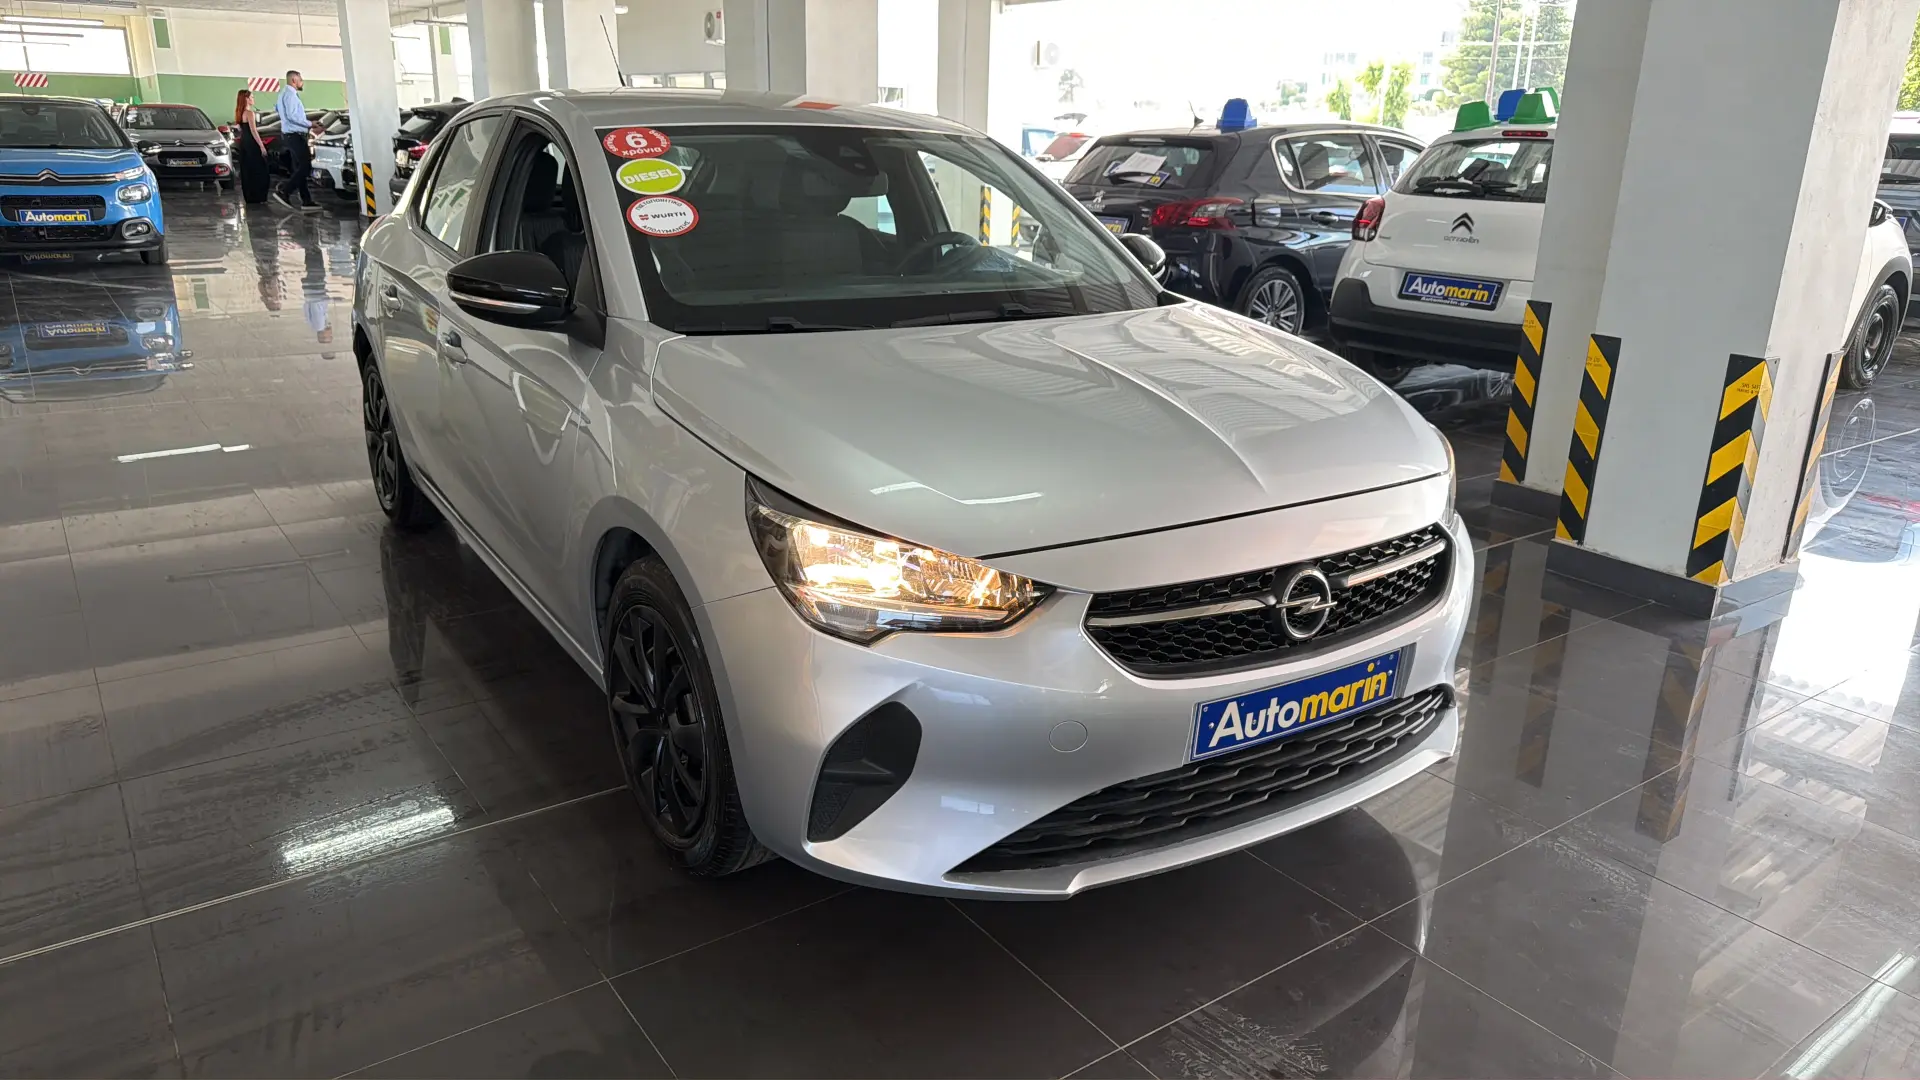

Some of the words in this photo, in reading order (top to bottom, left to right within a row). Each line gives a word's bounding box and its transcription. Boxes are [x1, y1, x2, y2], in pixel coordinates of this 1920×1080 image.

[625, 133, 648, 148] 6
[622, 146, 662, 156] χρόνια
[623, 168, 678, 184] DIESEL
[26, 210, 87, 222] Automarin
[1408, 276, 1489, 302] Automarin
[1208, 661, 1388, 748] Automarin
